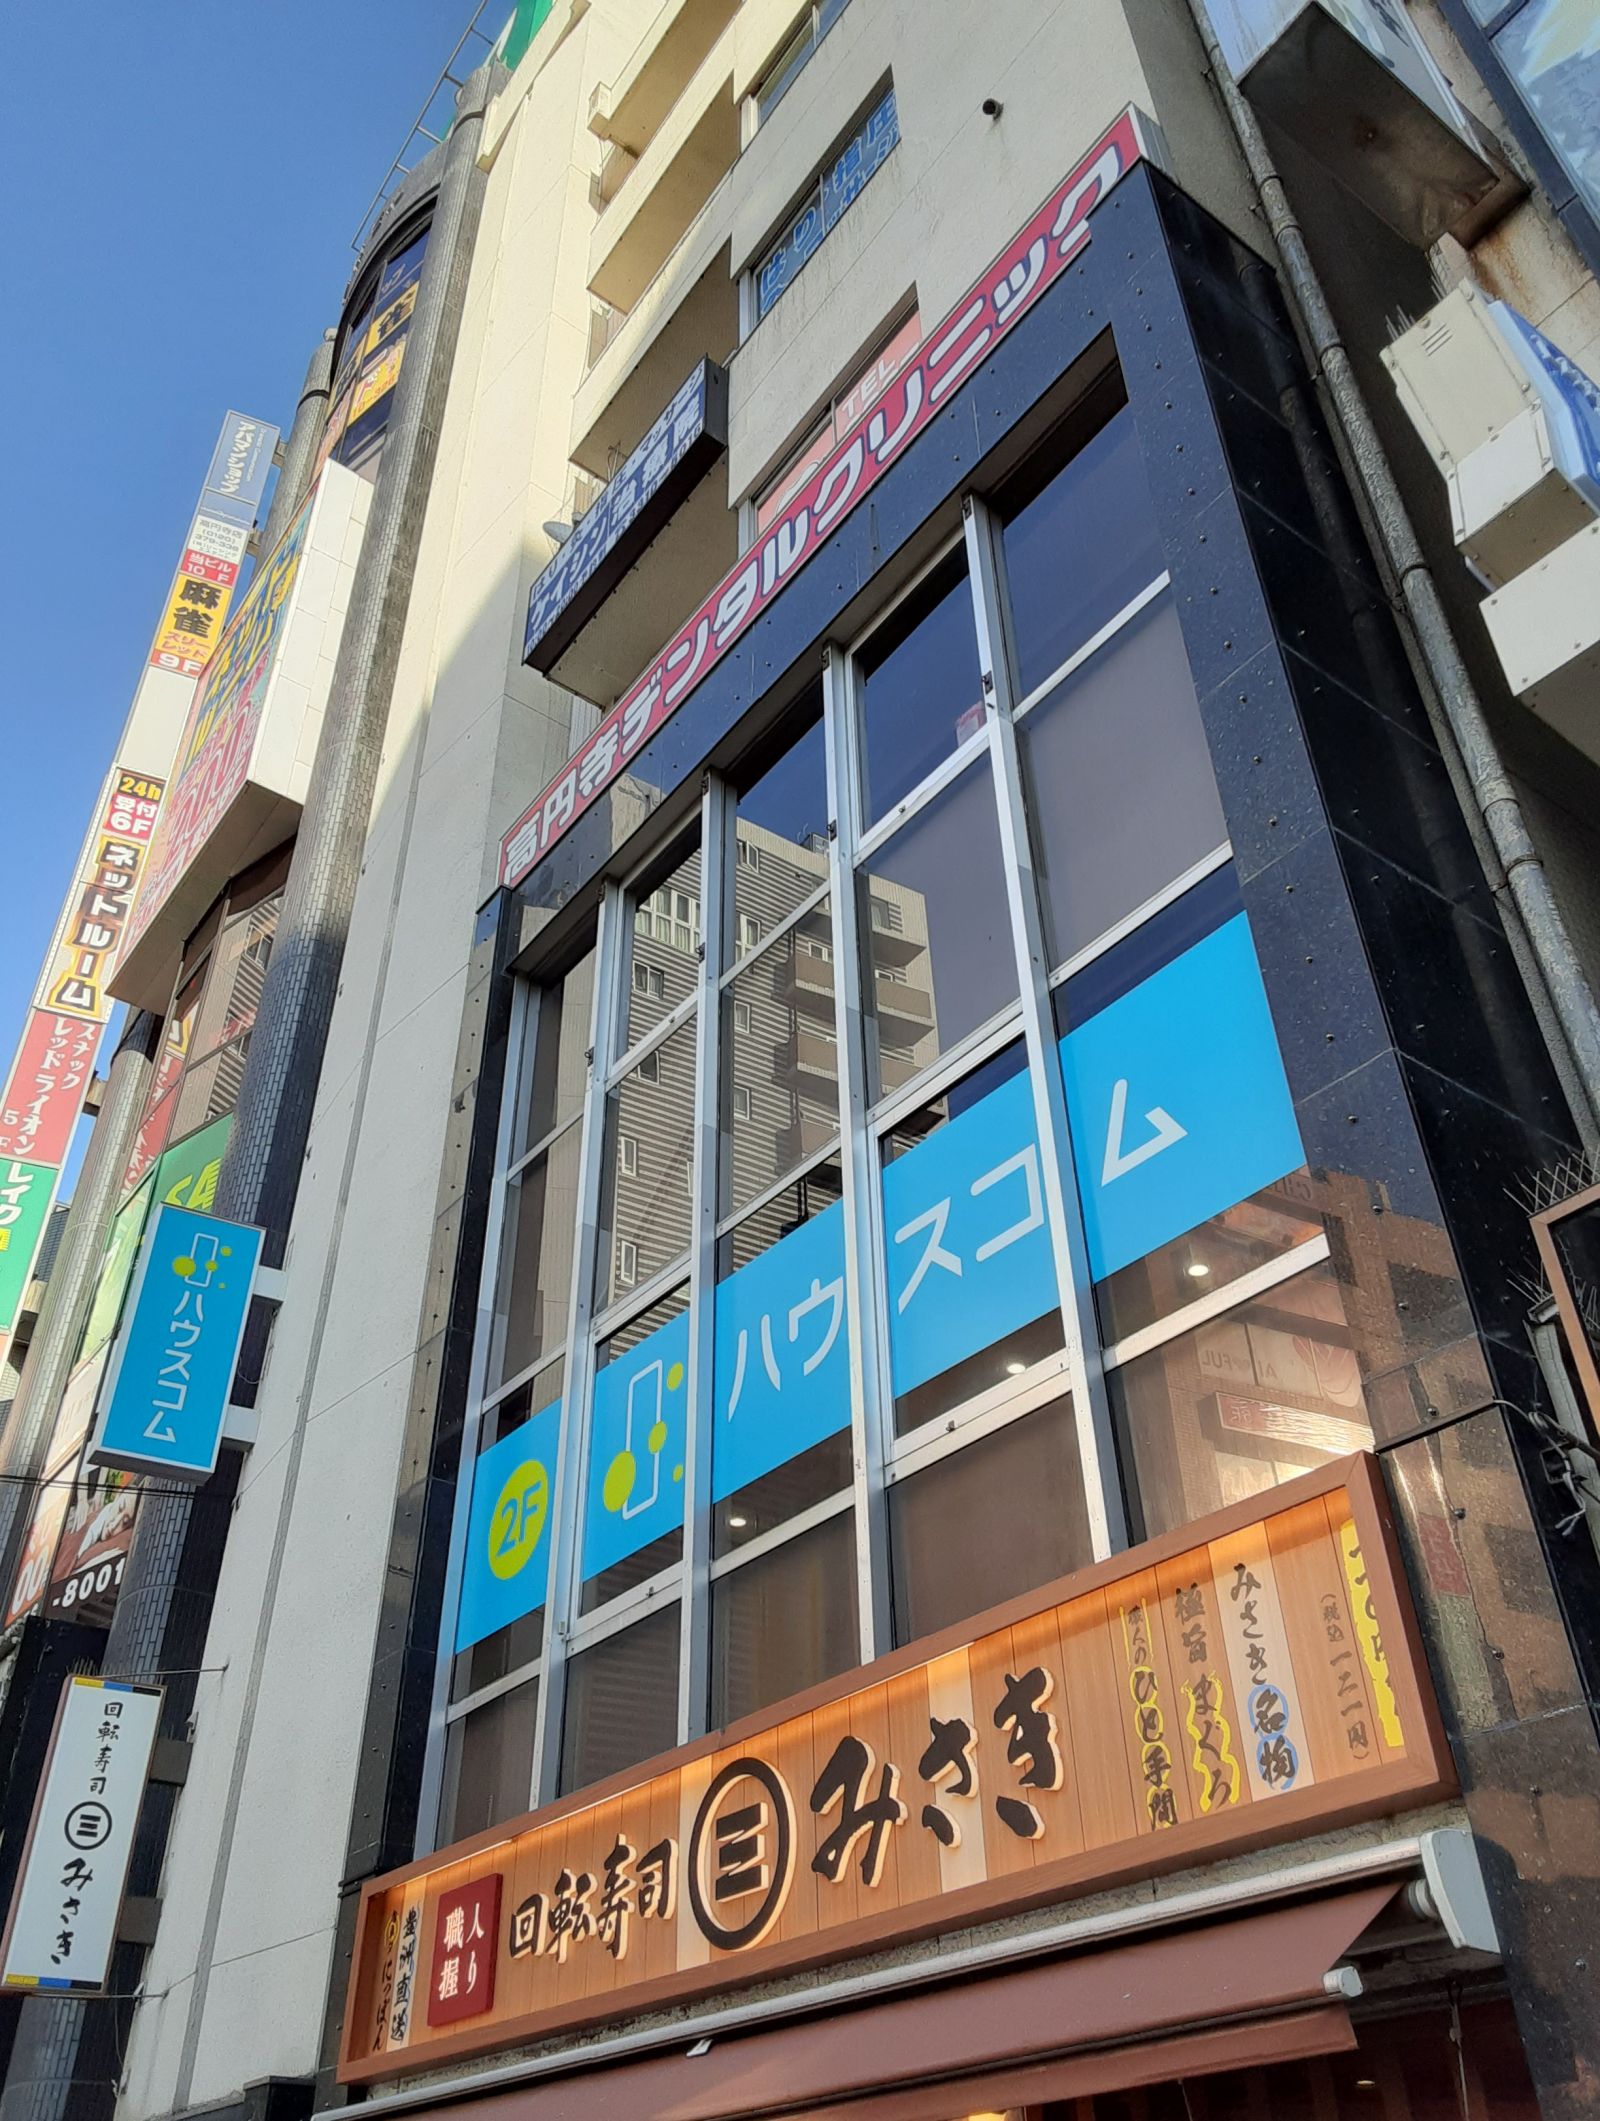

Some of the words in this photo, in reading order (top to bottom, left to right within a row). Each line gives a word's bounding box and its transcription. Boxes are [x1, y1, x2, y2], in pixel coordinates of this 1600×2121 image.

[842, 358, 896, 421] TEL
[503, 144, 1120, 886] 高円寺デンタルクリニック
[531, 392, 700, 631] ケイシン治療院
[187, 563, 206, 576] 10
[216, 573, 230, 583] F
[188, 551, 232, 573] 当ビル
[173, 578, 222, 640] 麻雀
[158, 652, 203, 674] 9F
[110, 812, 152, 835] 6F
[113, 794, 158, 818] 受付
[121, 776, 162, 801] 24h
[61, 843, 136, 1009] ネットルーム
[14, 1016, 74, 1155] レッドライオン
[60, 1022, 96, 1091] スナック
[728, 1078, 1189, 1423] ハウスコム
[143, 1290, 205, 1443] ハウスコム
[494, 1480, 543, 1559] 2F
[89, 1701, 124, 1796] 回転寿司
[809, 1666, 1065, 1888] みさき
[50, 1856, 94, 1965] みさき
[509, 1832, 679, 1963] 回転寿司
